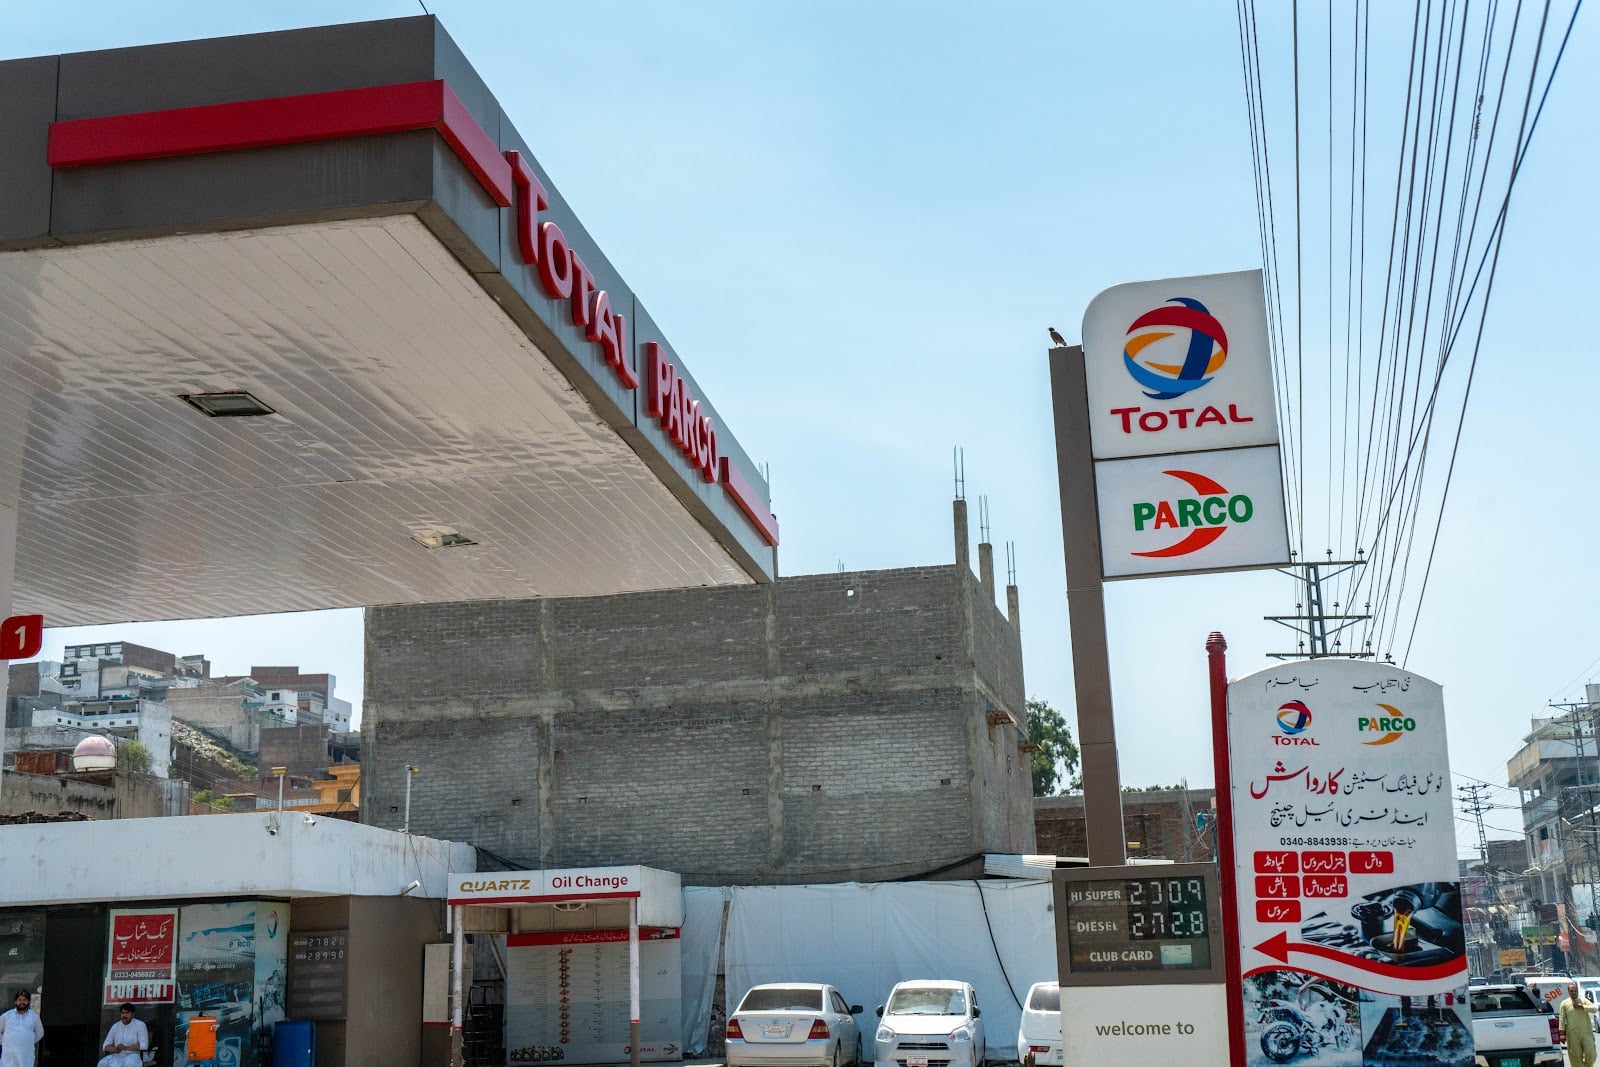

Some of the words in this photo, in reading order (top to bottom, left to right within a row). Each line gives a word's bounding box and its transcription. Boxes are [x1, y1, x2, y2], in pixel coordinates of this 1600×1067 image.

[505, 150, 638, 389] TOTAL
[647, 341, 719, 483] PARCO
[1110, 403, 1254, 434] TOTAL
[1132, 494, 1254, 532] PARCO
[14, 625, 27, 650] 1
[1358, 717, 1416, 732] PARCO
[1271, 735, 1321, 746] TOTAL
[1280, 837, 1348, 846] 0340-8843938
[460, 879, 531, 893] QUARTZ
[552, 877, 572, 889] Oil
[575, 875, 629, 889] Change
[1085, 890, 1121, 901] SUPER
[1076, 921, 1119, 933] DIESEL
[1089, 952, 1119, 963] CLUB
[1121, 950, 1154, 961] CARD
[1096, 1021, 1171, 1036] welcome
[1176, 1021, 1195, 1035] to
